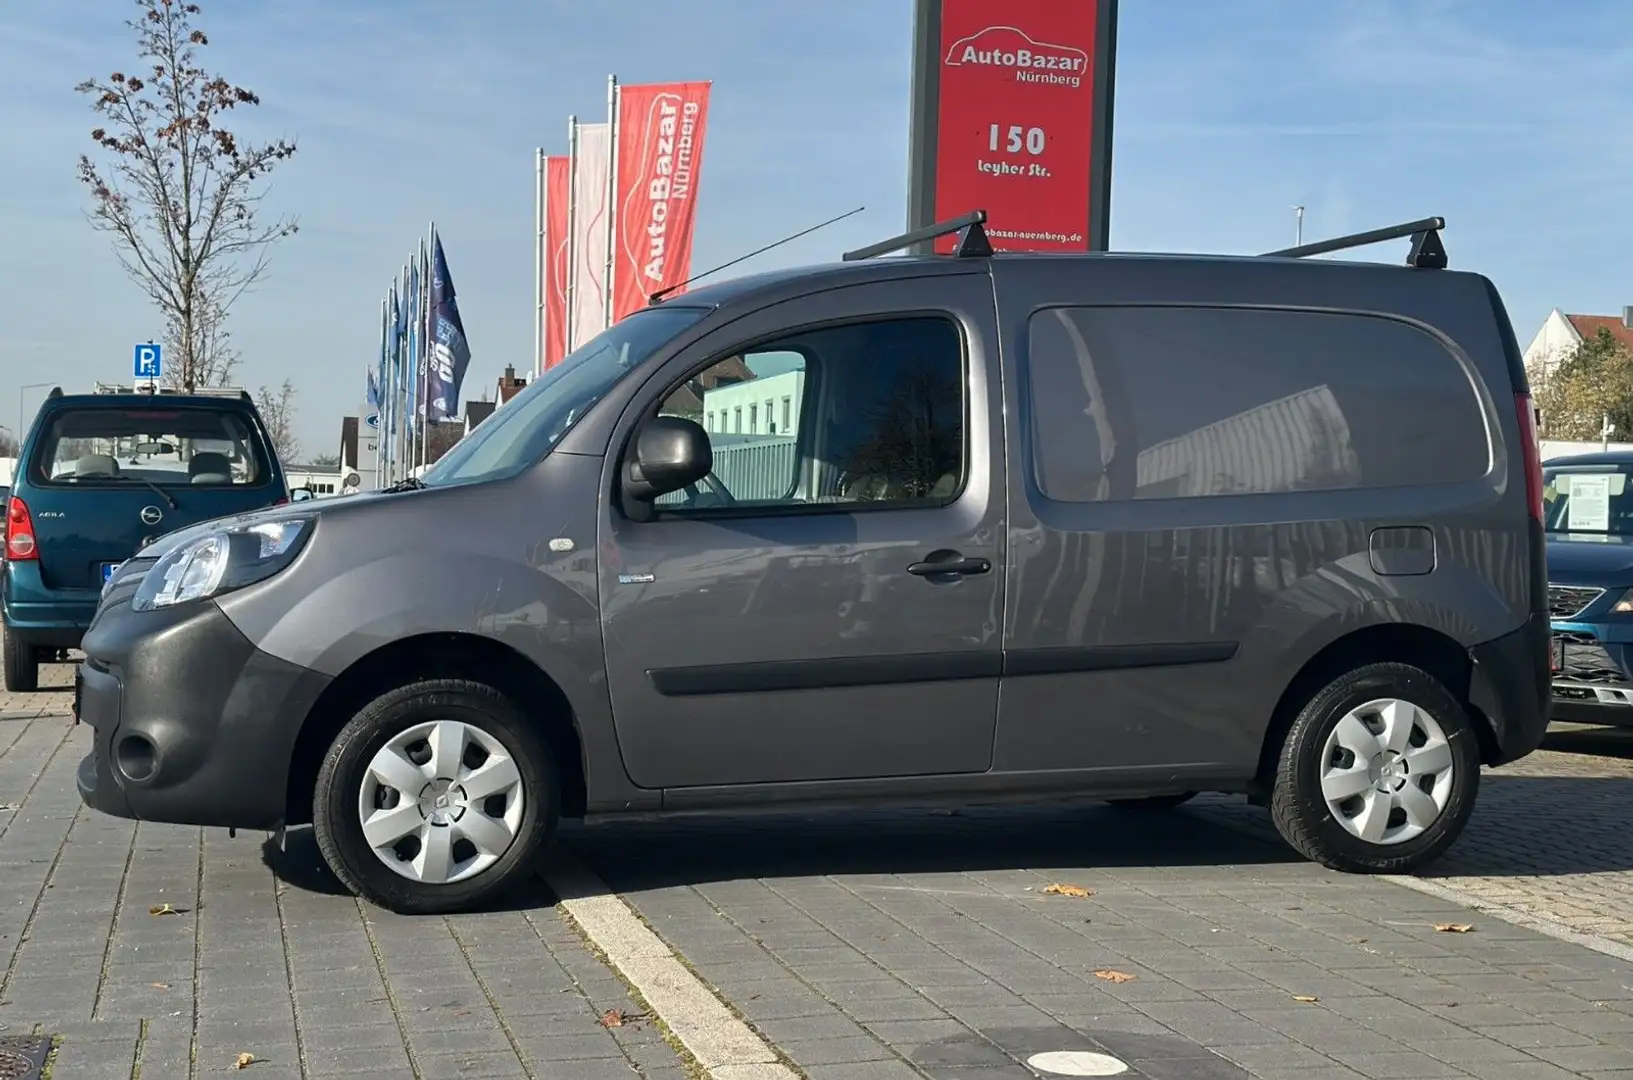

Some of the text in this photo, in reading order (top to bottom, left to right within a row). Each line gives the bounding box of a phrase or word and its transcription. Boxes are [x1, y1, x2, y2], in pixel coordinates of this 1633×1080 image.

[961, 46, 1082, 71] AutoBazar
[1016, 70, 1080, 88] Nürnberg
[672, 101, 698, 199] Nürnberg
[989, 123, 1045, 155] 150
[977, 159, 1051, 177] Leyher Str.
[644, 100, 678, 283] AutoBazar
[984, 228, 1082, 243] obazar-nuernberg.de
[140, 348, 155, 373] P
